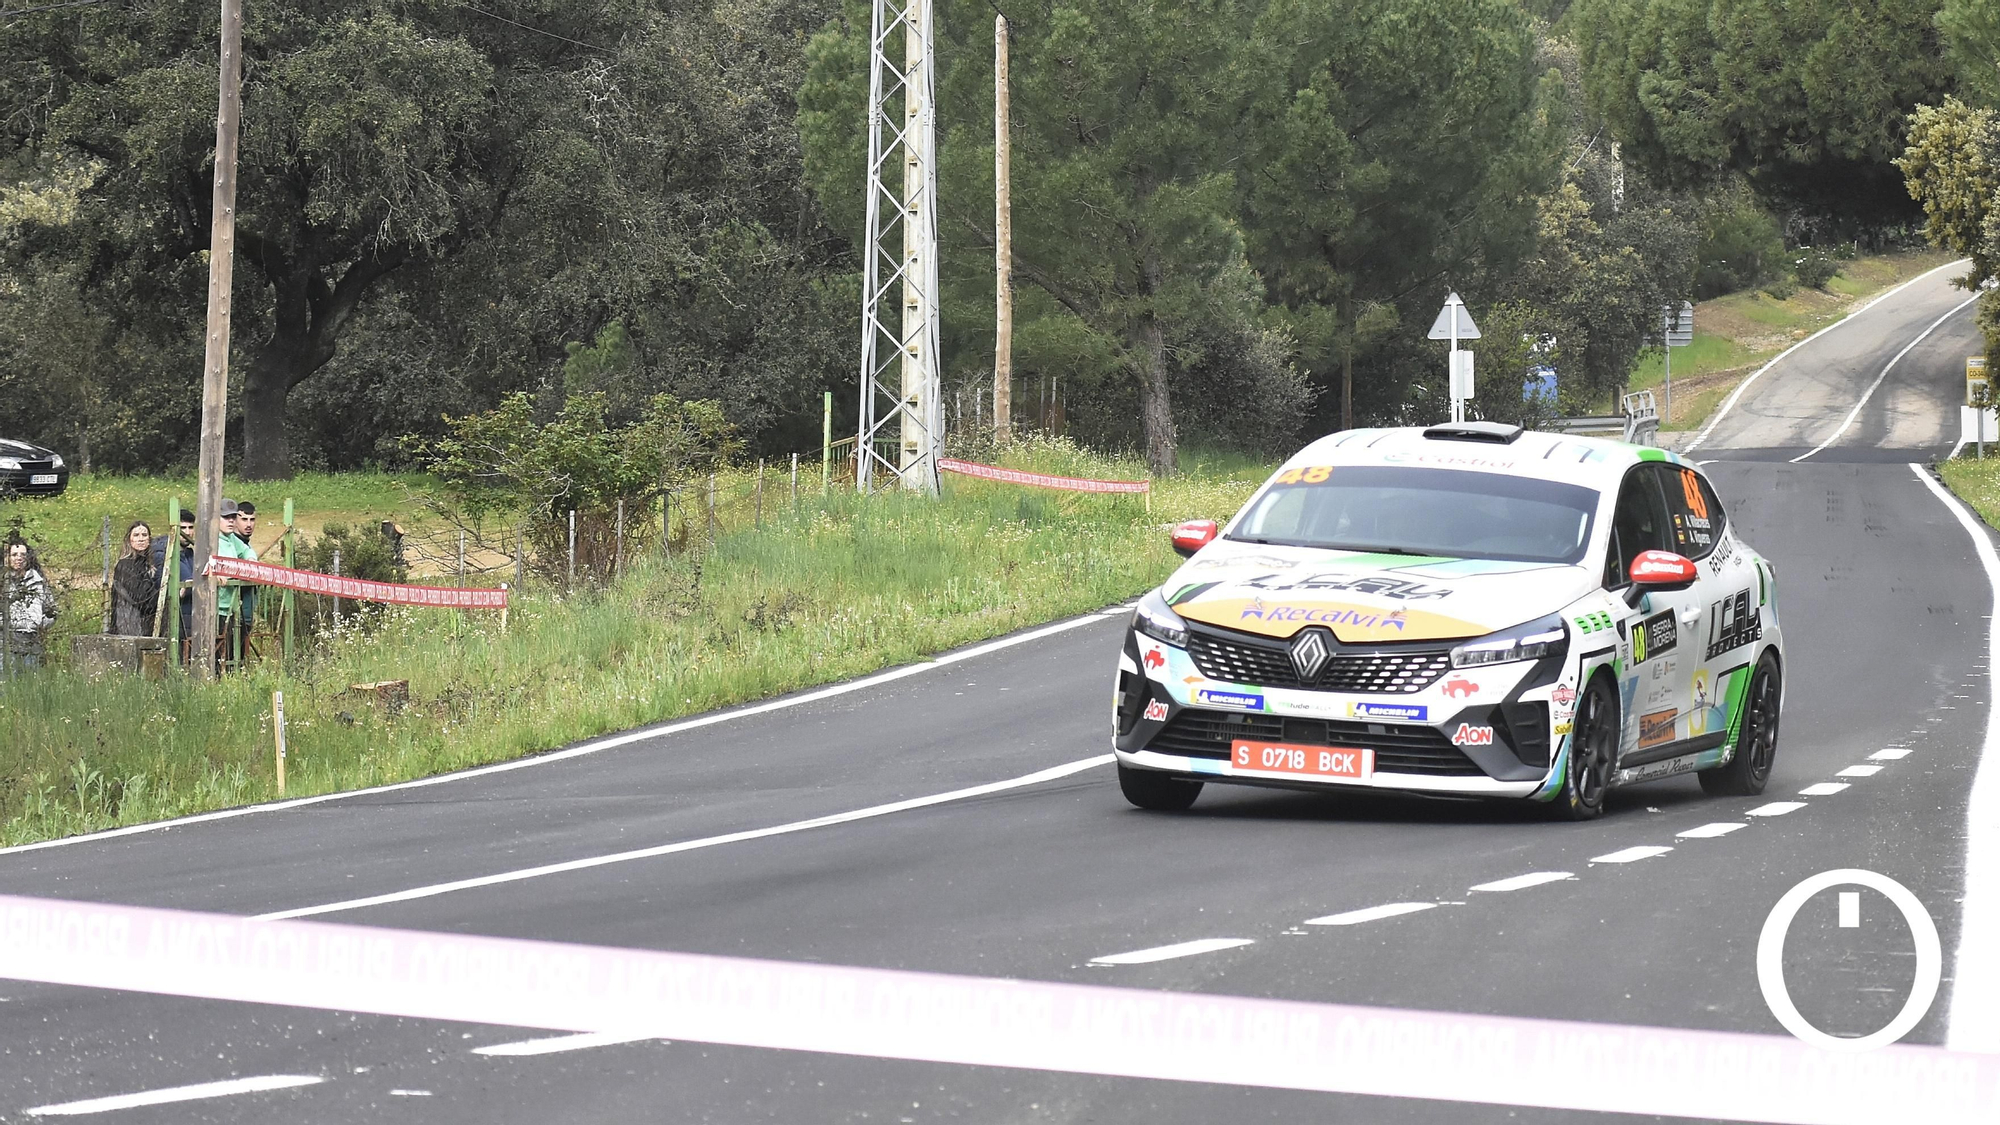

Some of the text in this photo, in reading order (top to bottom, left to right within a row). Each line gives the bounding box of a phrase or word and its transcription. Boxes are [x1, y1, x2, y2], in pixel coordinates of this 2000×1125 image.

[1275, 465, 1334, 485] 48
[1680, 469, 1708, 519] 48
[1708, 535, 1734, 577] RENAULT
[1267, 606, 1382, 628] Recalvi
[1652, 618, 1673, 637] SIERRA
[1633, 625, 1646, 663] 48
[1653, 628, 1677, 649] MORENA
[1705, 628, 1763, 657] PROJECTS
[1209, 694, 1257, 706] MICHELIN
[1368, 706, 1420, 717] MICHELIN
[1237, 745, 1356, 774] S 0718 BCK
